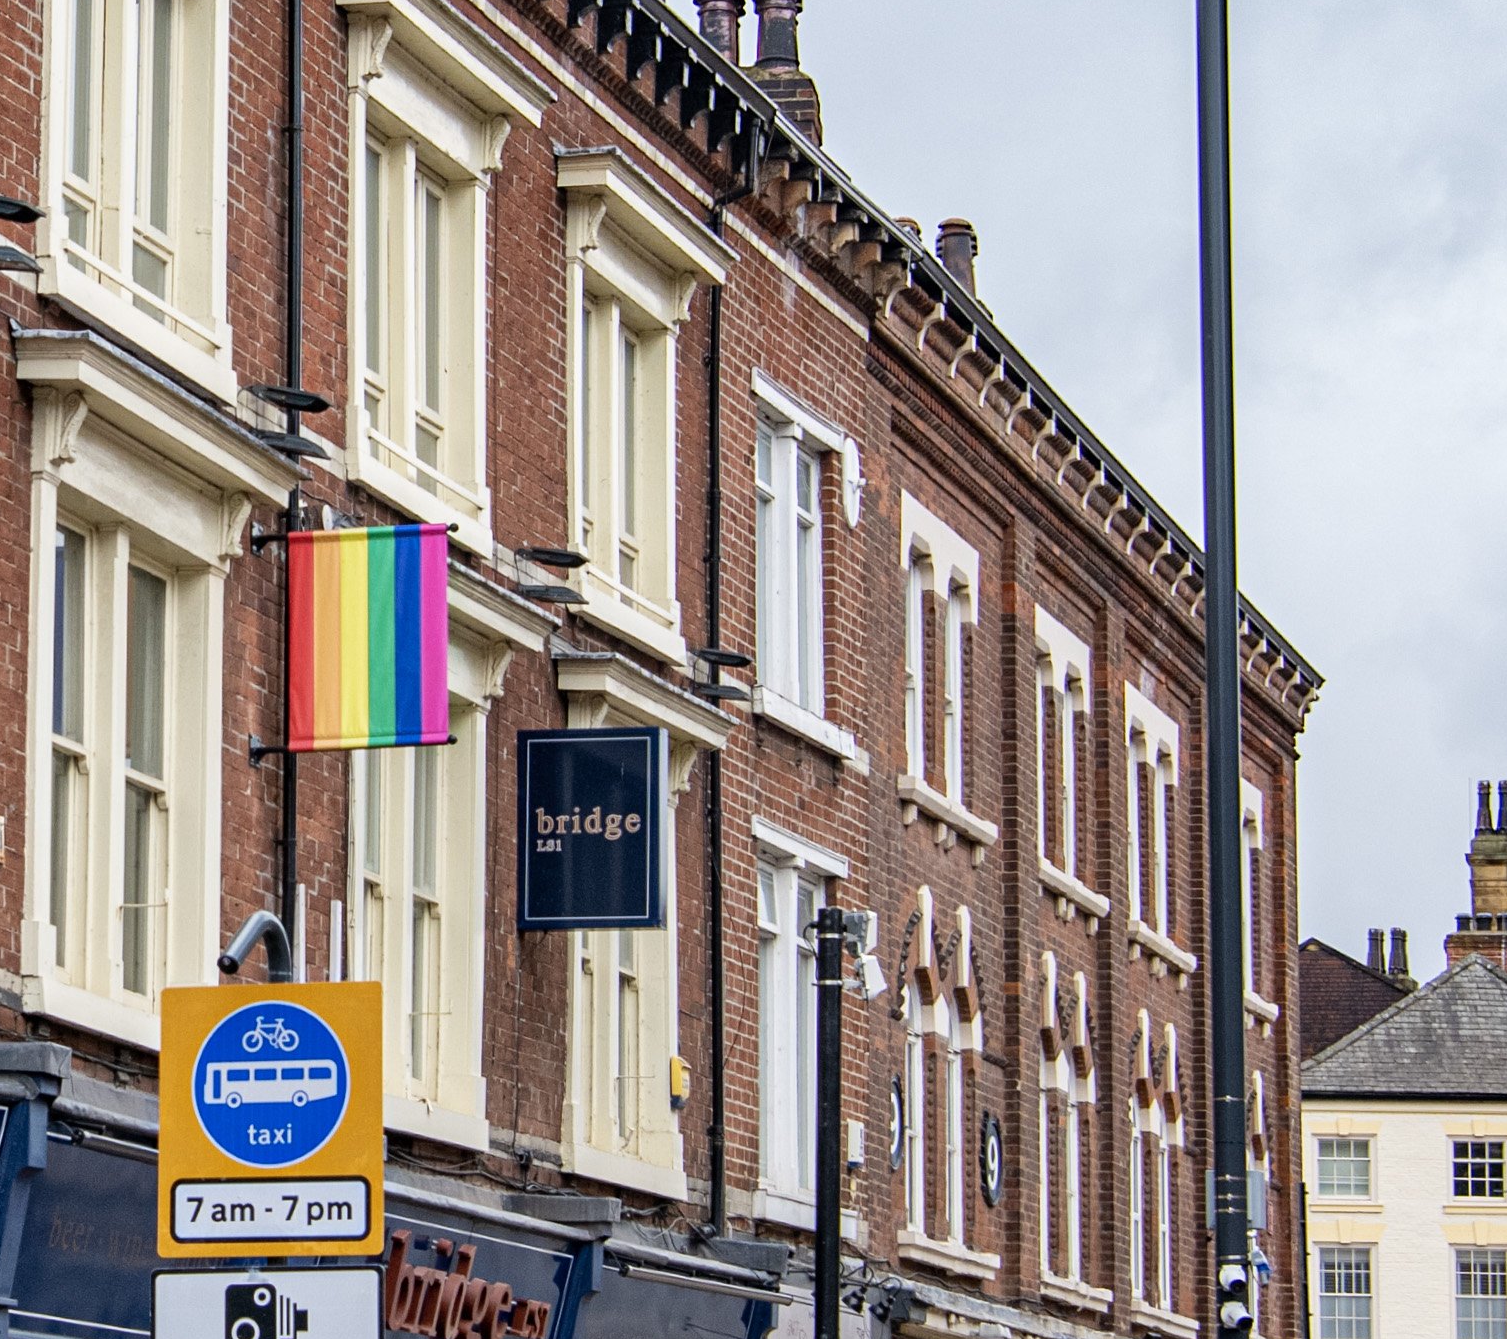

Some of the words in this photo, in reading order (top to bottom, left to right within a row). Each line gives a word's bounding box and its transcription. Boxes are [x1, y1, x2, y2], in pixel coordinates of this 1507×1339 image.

[535, 806, 641, 841] bridge
[536, 839, 563, 852] LS1
[247, 1123, 293, 1146] taxi
[187, 1197, 204, 1223] 7
[210, 1203, 255, 1223] am
[281, 1196, 299, 1222] 7
[306, 1203, 354, 1228] pm
